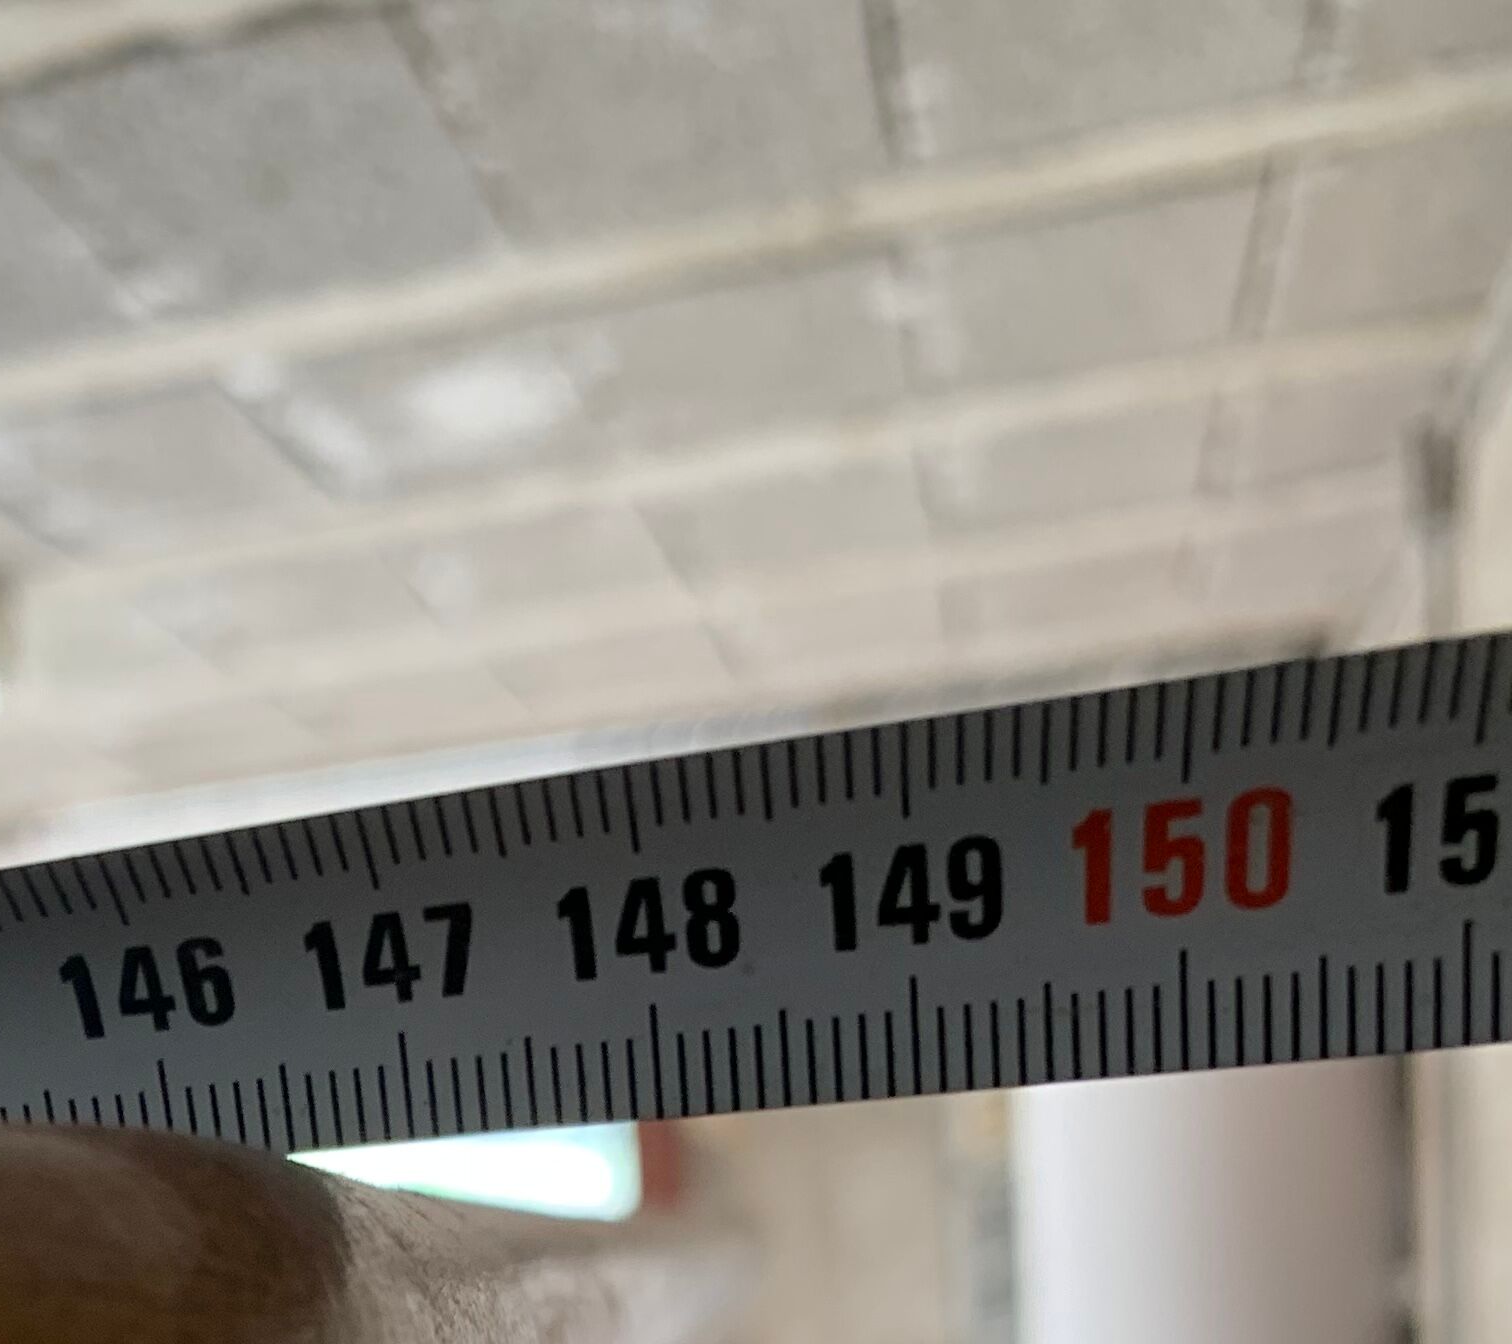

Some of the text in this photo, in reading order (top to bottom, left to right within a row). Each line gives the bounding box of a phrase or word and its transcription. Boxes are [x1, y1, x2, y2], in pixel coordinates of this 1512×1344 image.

[58, 937, 236, 1039] 146
[302, 903, 472, 1011] 147
[556, 867, 741, 981] 148
[819, 836, 1004, 952] 149
[1072, 787, 1295, 926] 150
[1376, 774, 1500, 894] 15
